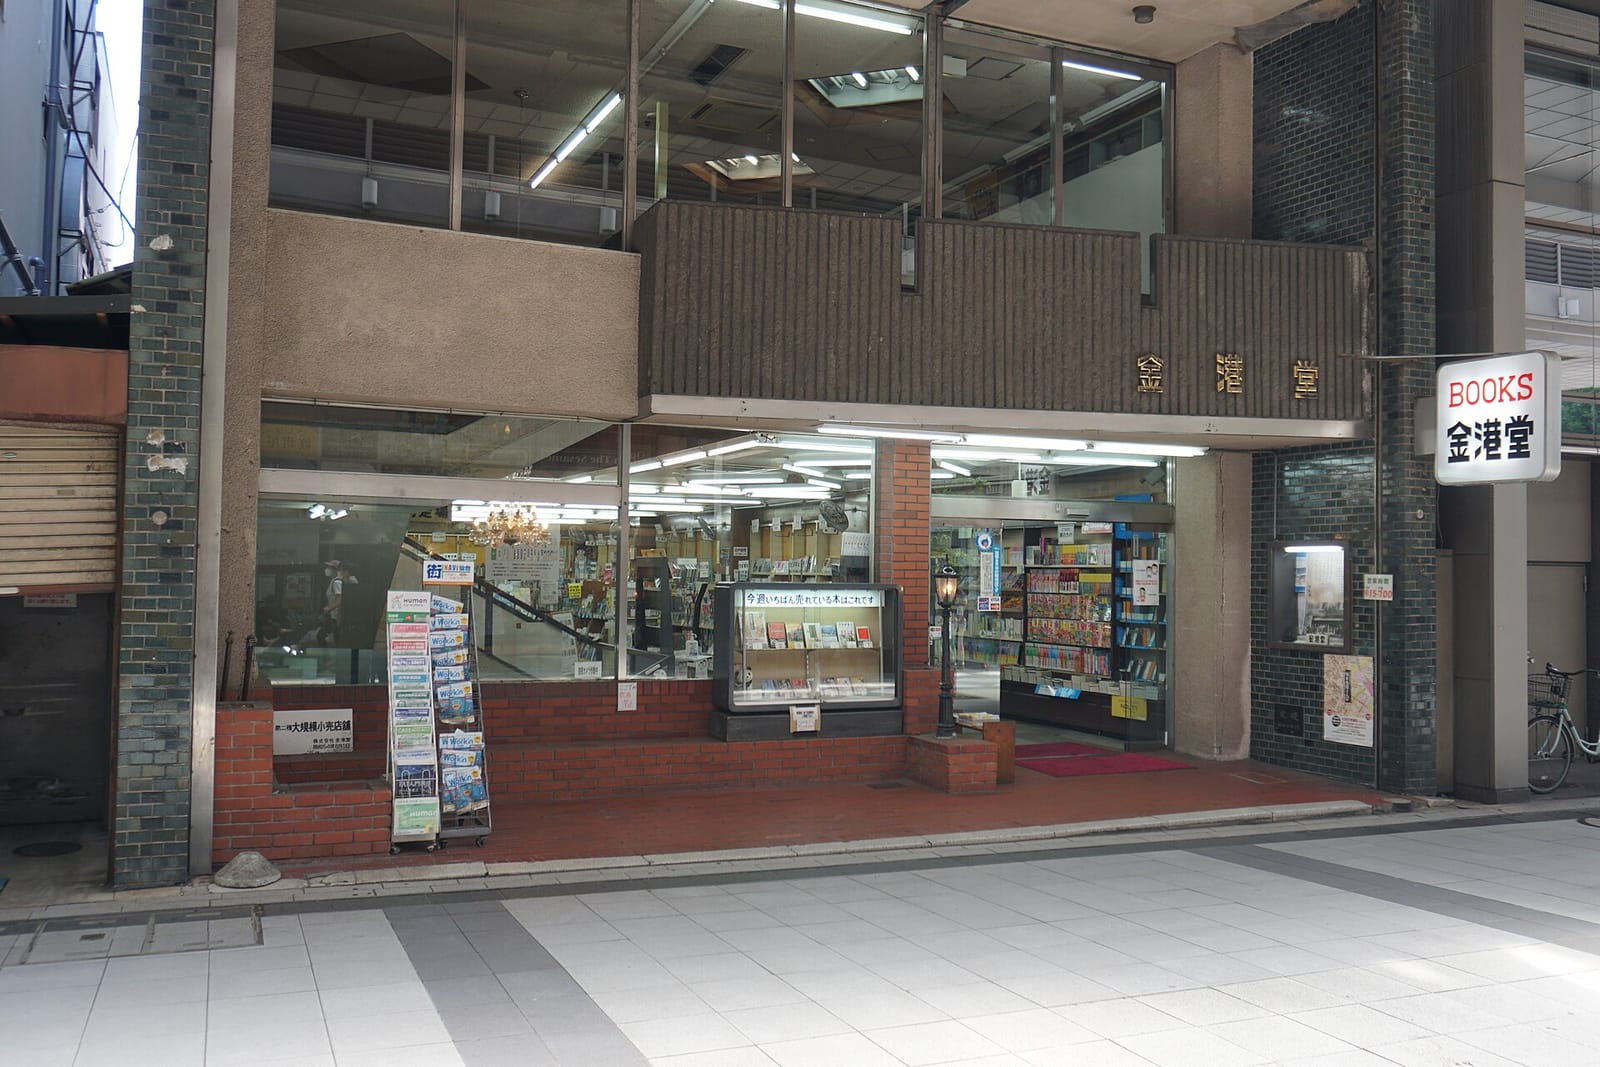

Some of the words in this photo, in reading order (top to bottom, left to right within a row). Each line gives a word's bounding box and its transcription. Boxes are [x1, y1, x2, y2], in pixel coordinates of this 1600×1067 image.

[1137, 352, 1320, 399] 金港堂
[1448, 372, 1533, 408] BOOKS
[1447, 414, 1534, 463] 金港堂
[746, 593, 874, 605] 今週いちばん売れている本はこれです
